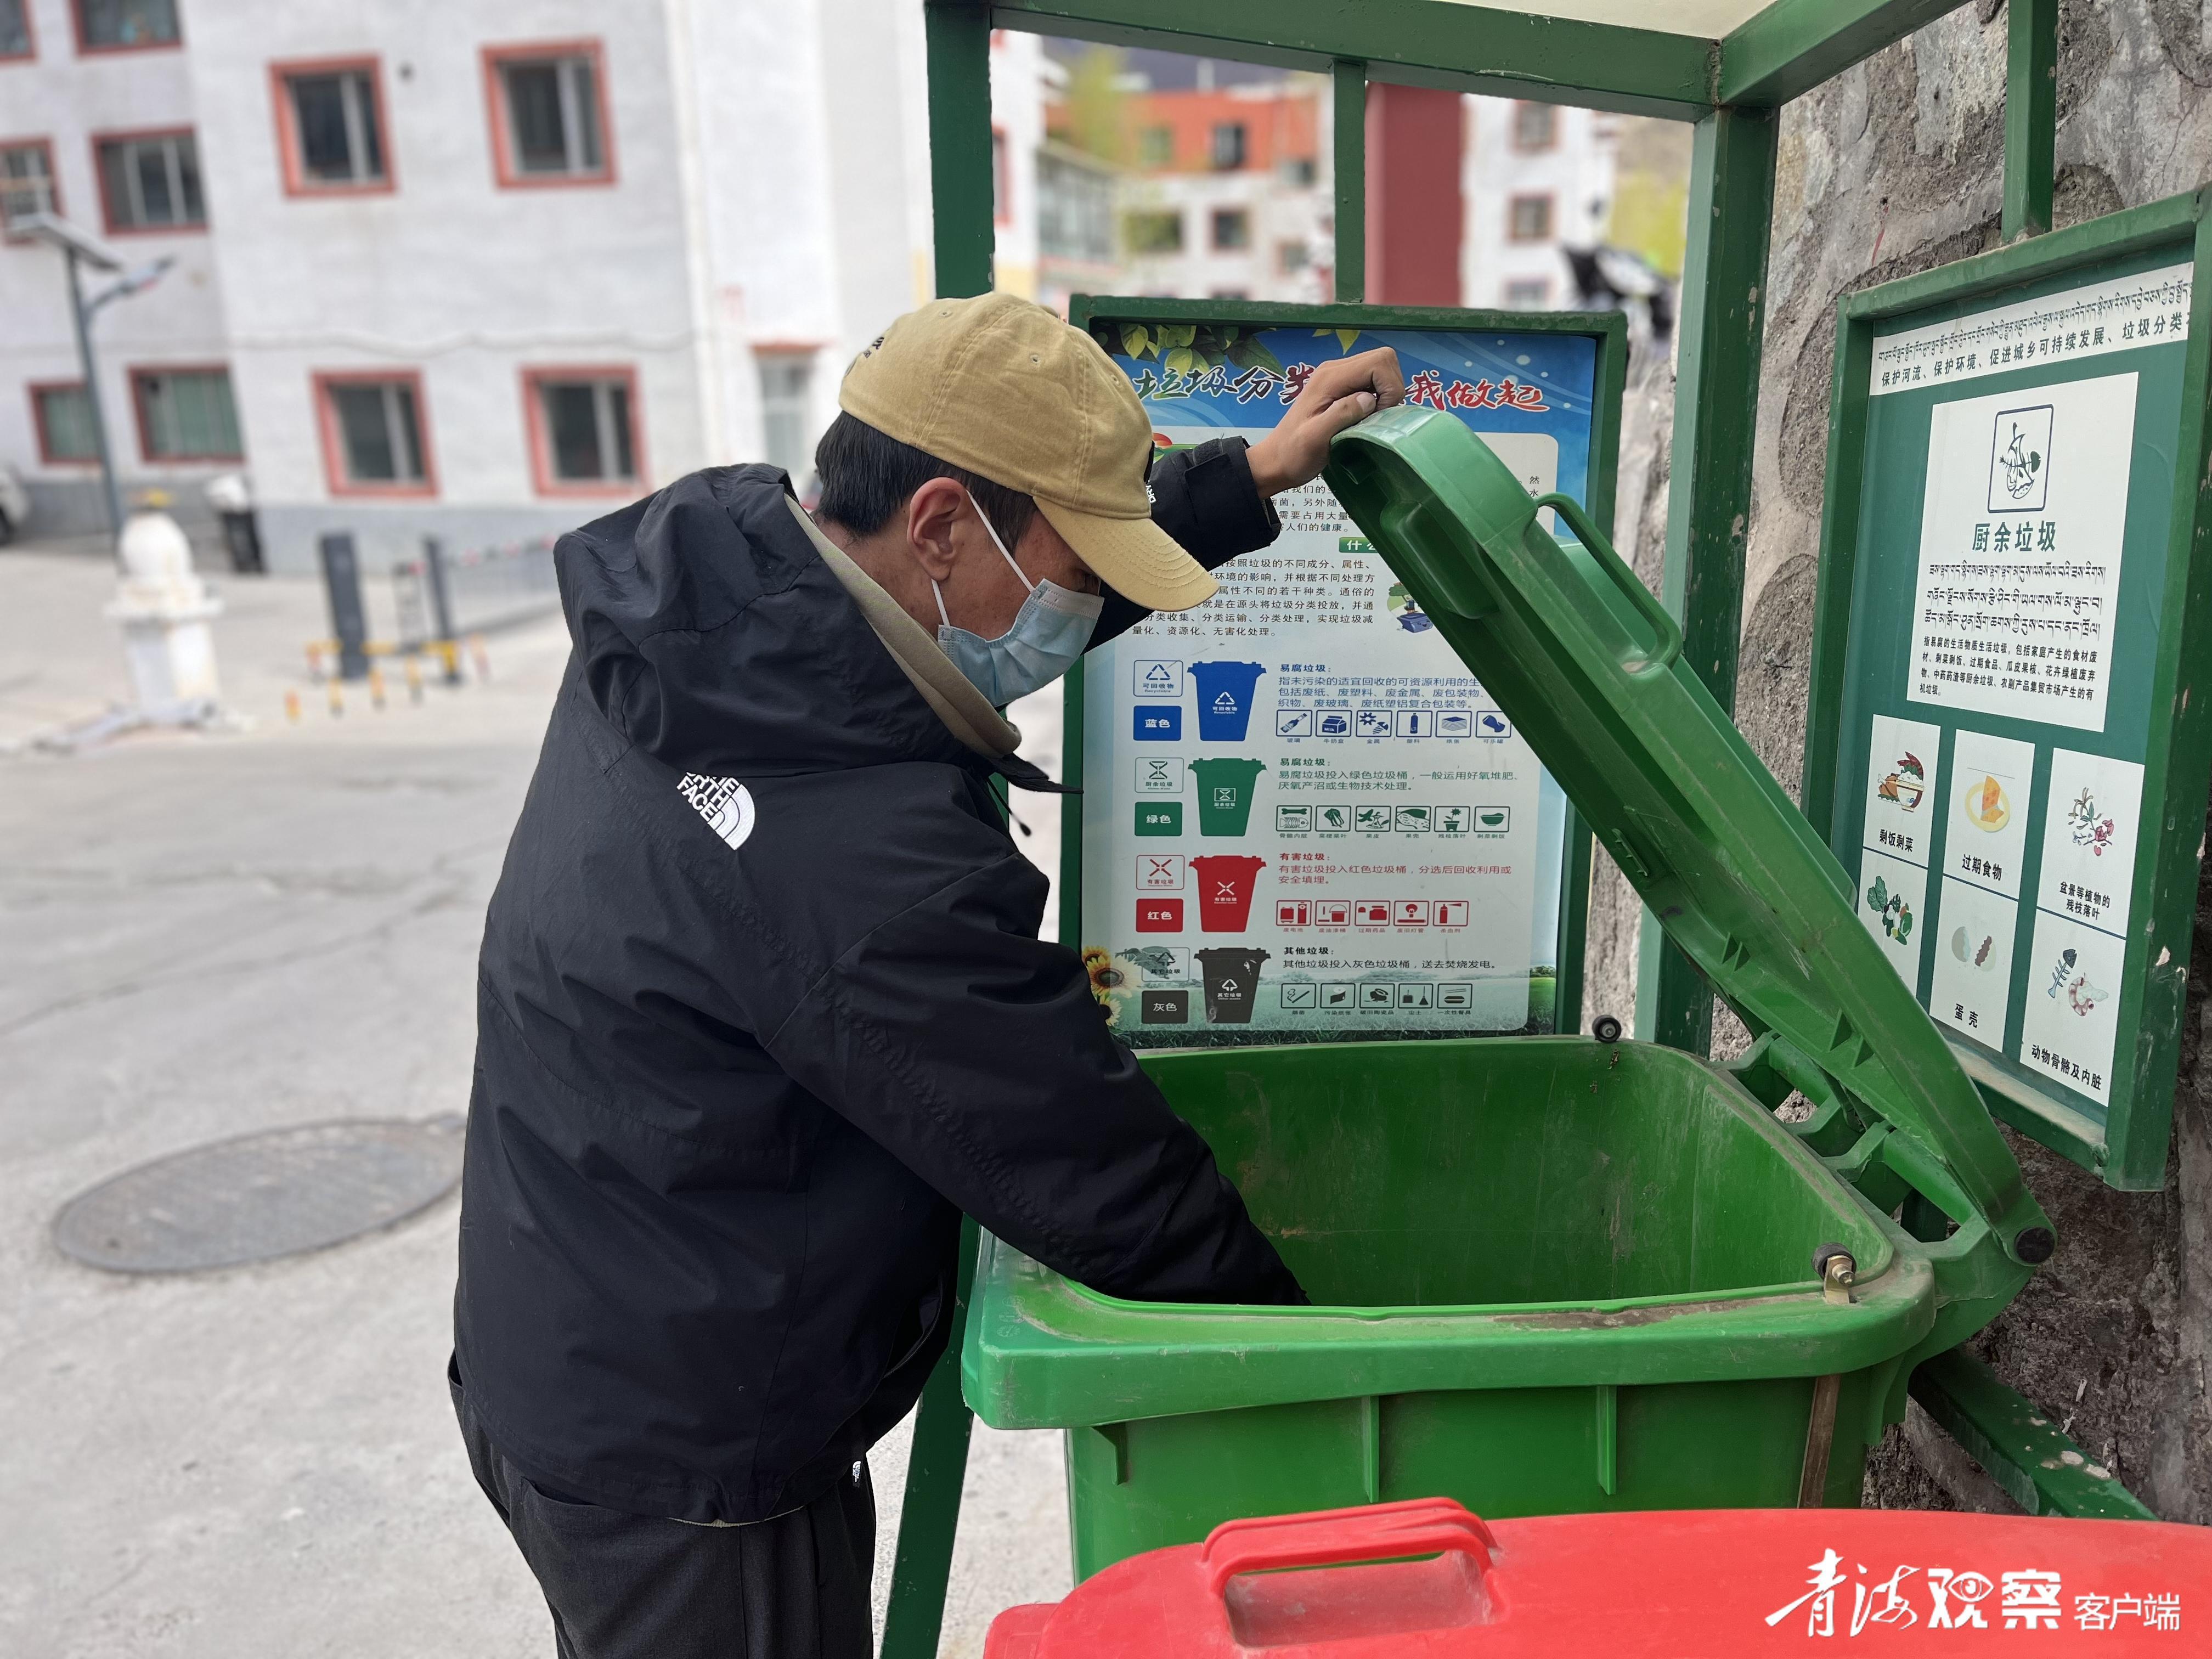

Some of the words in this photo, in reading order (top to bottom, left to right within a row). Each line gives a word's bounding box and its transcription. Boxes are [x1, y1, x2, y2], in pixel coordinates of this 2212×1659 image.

[1398, 369, 1551, 411] 我做起
[1279, 511, 1352, 520] 需要占用大量
[1972, 521, 2057, 552] 厨余垃圾
[1195, 599, 1374, 610] 就是在源头将垃圾分类投放，并通
[1145, 719, 1171, 729] 蓝色
[676, 775, 719, 822] FACE
[1146, 815, 1171, 823] 绿色
[1880, 829, 1914, 853] 剩饭剩菜
[1280, 853, 1330, 861] 有害垃圾：
[1961, 854, 2002, 882] 过期食物
[1278, 876, 1329, 884] 安全填埋。
[2059, 881, 2111, 909] 盆景等植物的
[1147, 911, 1172, 920] 红色
[2066, 899, 2100, 921] 残枝落叶
[1284, 947, 1334, 955] 其他垃圾：
[1153, 1003, 1177, 1012] 灰色
[1954, 1003, 1978, 1029] 蛋壳
[2031, 1043, 2102, 1092] 动物骨骼及内脏
